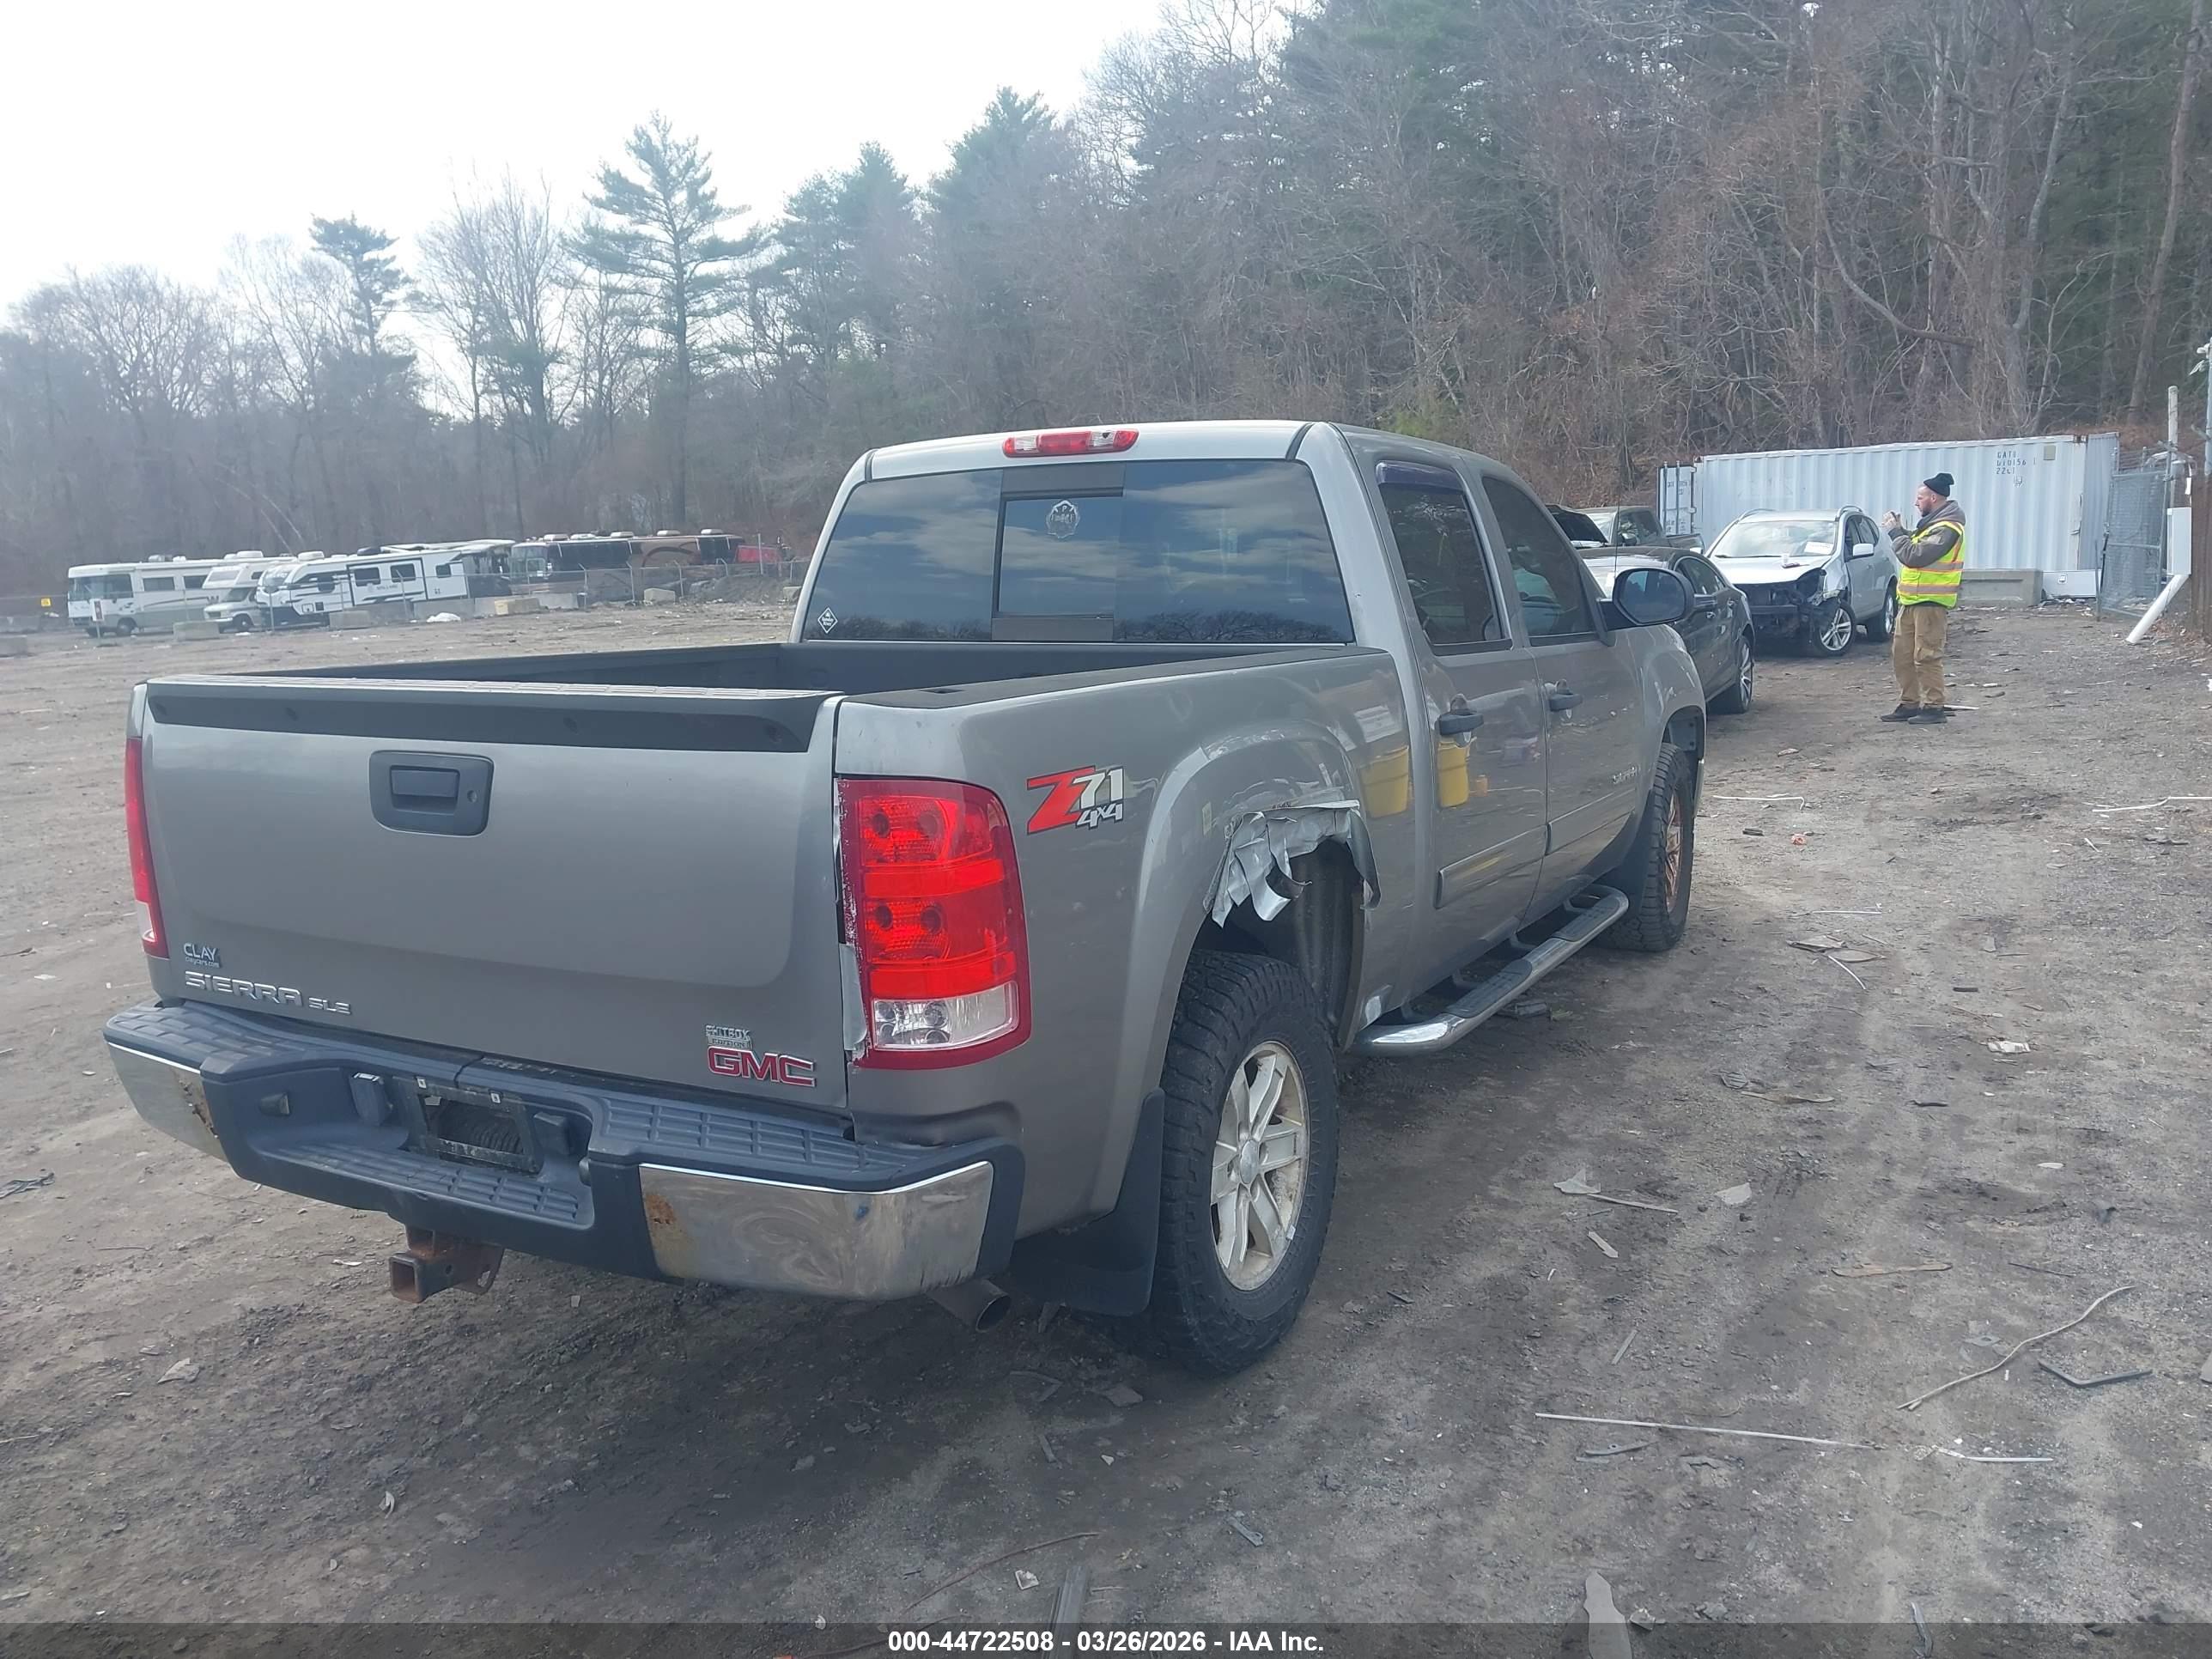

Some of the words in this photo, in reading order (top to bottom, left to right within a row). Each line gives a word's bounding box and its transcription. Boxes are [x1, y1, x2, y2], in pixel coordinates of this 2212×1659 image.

[1026, 765, 1125, 836] Z71
[183, 943, 217, 963] CLAY
[185, 970, 304, 1007] SIERRA
[307, 996, 352, 1016] SLE
[707, 1045, 817, 1088] GMC
